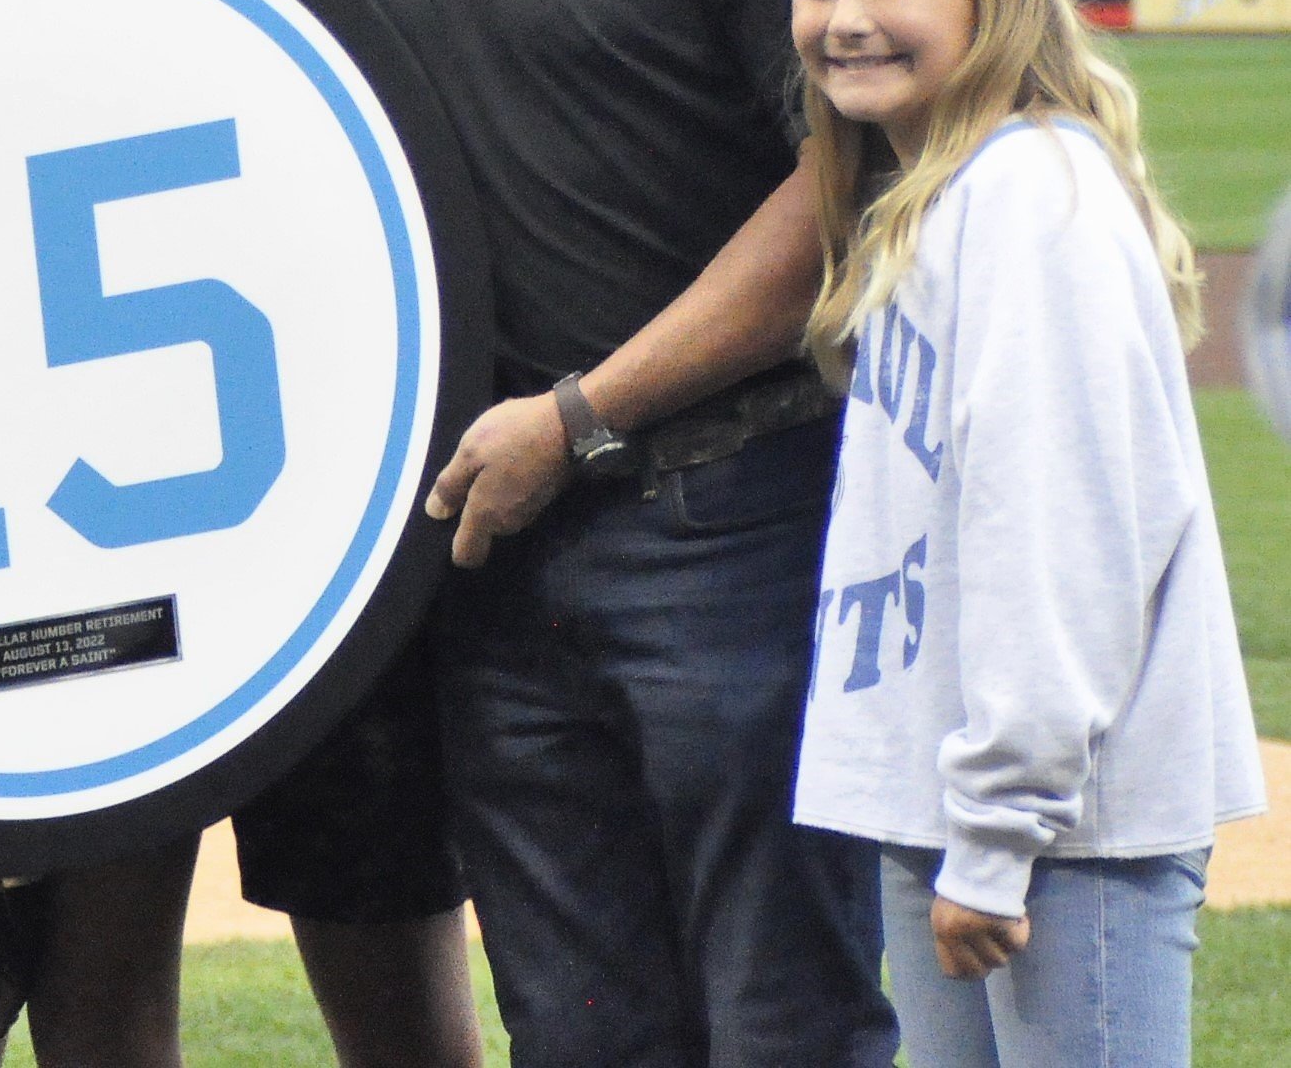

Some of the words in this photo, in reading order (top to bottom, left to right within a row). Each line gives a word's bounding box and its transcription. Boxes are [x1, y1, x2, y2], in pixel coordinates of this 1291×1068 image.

[31, 622, 82, 642] NUMBER
[85, 607, 164, 631] RETIREMENT
[3, 645, 51, 663] AUGUST
[55, 640, 73, 654] 13,
[76, 634, 105, 649] 2022
[59, 657, 69, 668] A
